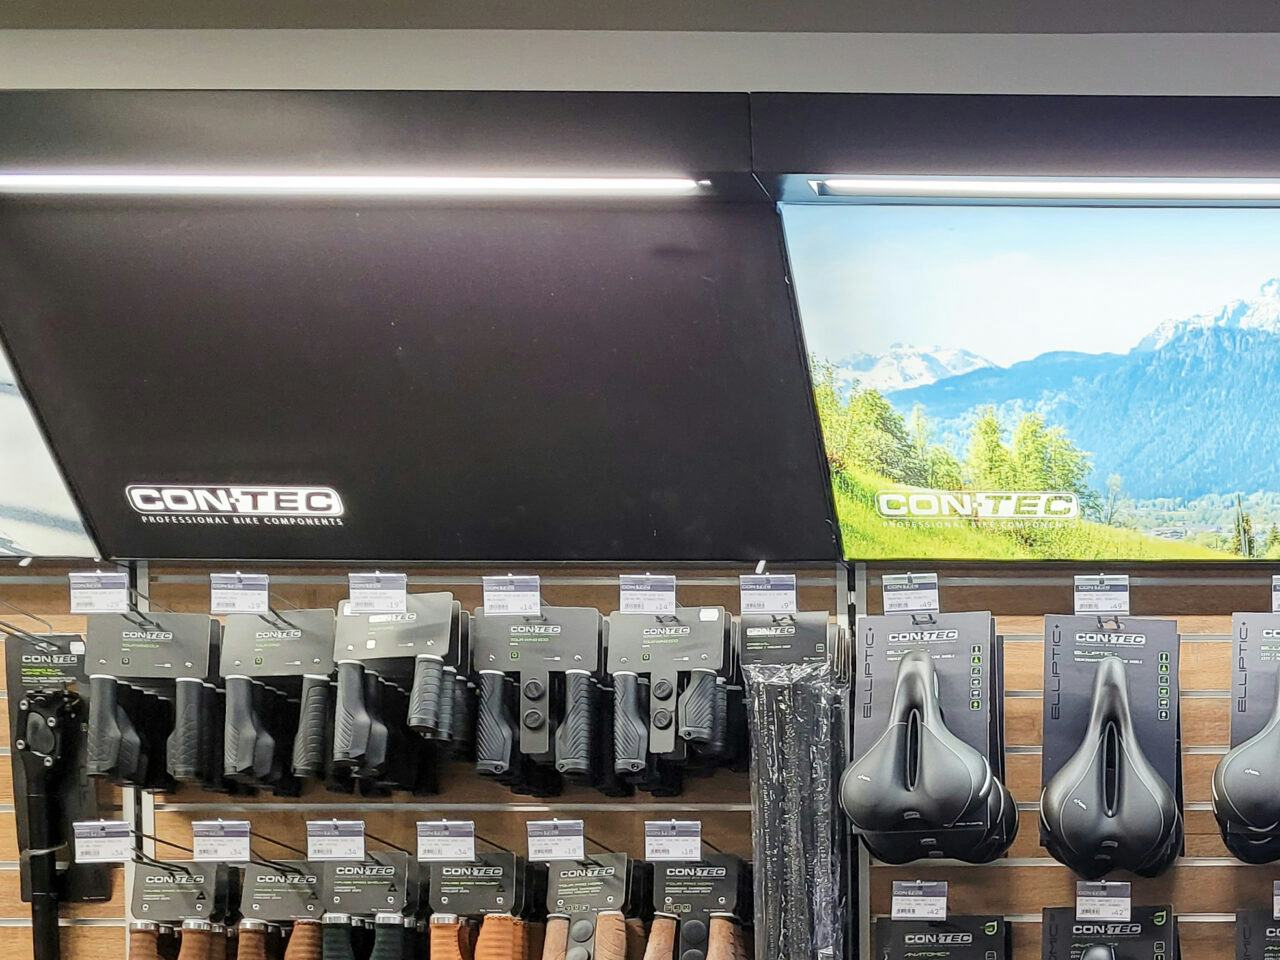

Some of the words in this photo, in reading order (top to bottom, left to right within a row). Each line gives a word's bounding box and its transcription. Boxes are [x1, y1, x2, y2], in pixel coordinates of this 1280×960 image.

[141, 515, 229, 524] PROFESSIONAL
[234, 517, 260, 525] BIKE
[264, 517, 343, 526] COMPONENTS
[882, 520, 965, 528] PROFESSIONAL
